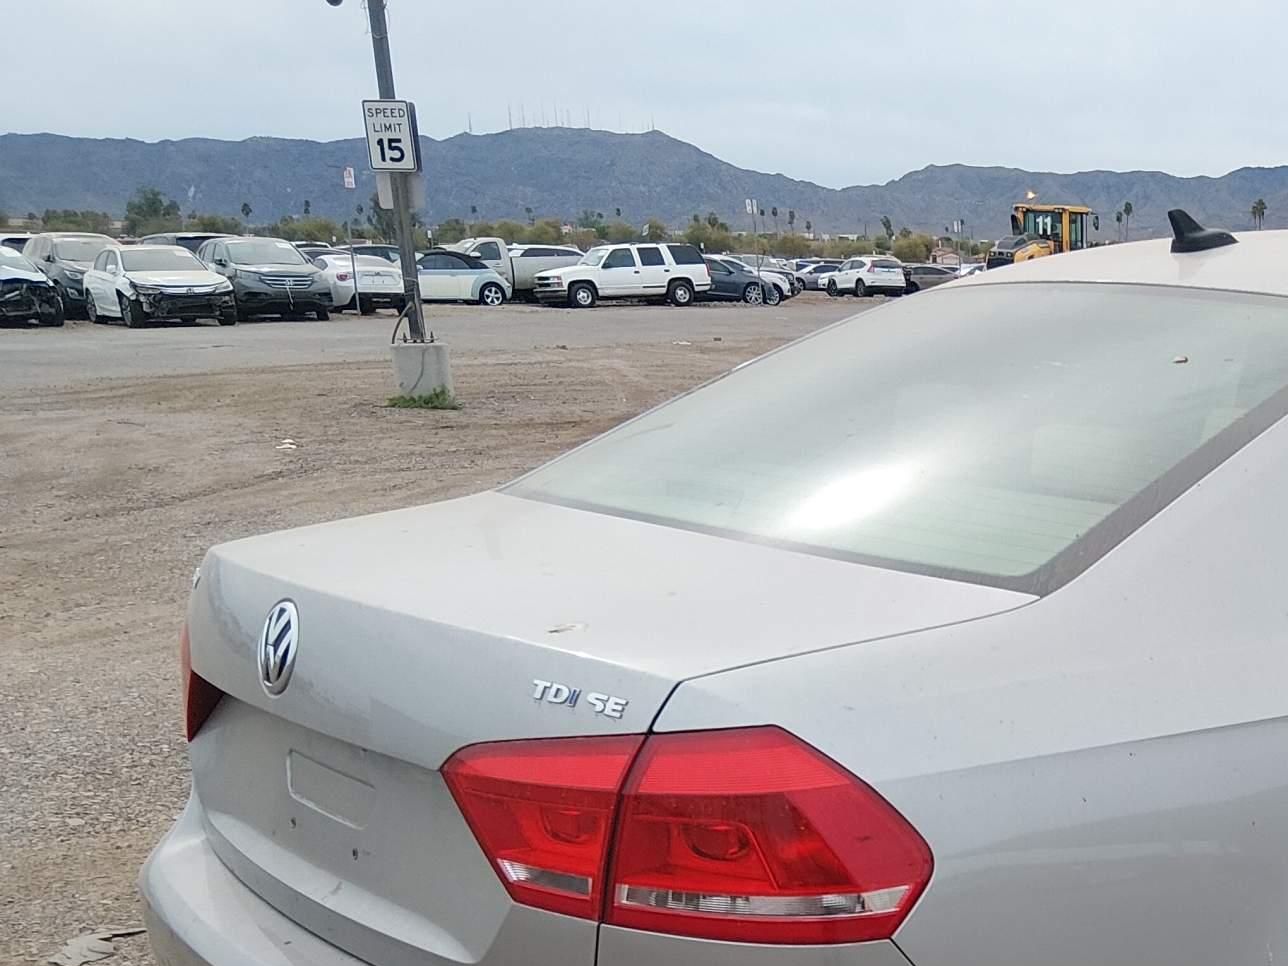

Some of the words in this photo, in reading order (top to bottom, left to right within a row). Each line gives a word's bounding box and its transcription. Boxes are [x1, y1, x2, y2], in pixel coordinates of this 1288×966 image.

[367, 108, 405, 118] SPEED
[373, 122, 402, 133] LIMIT
[376, 138, 405, 163] 15
[1036, 215, 1052, 235] 11
[532, 679, 581, 707] TDI
[586, 691, 628, 719] SE
